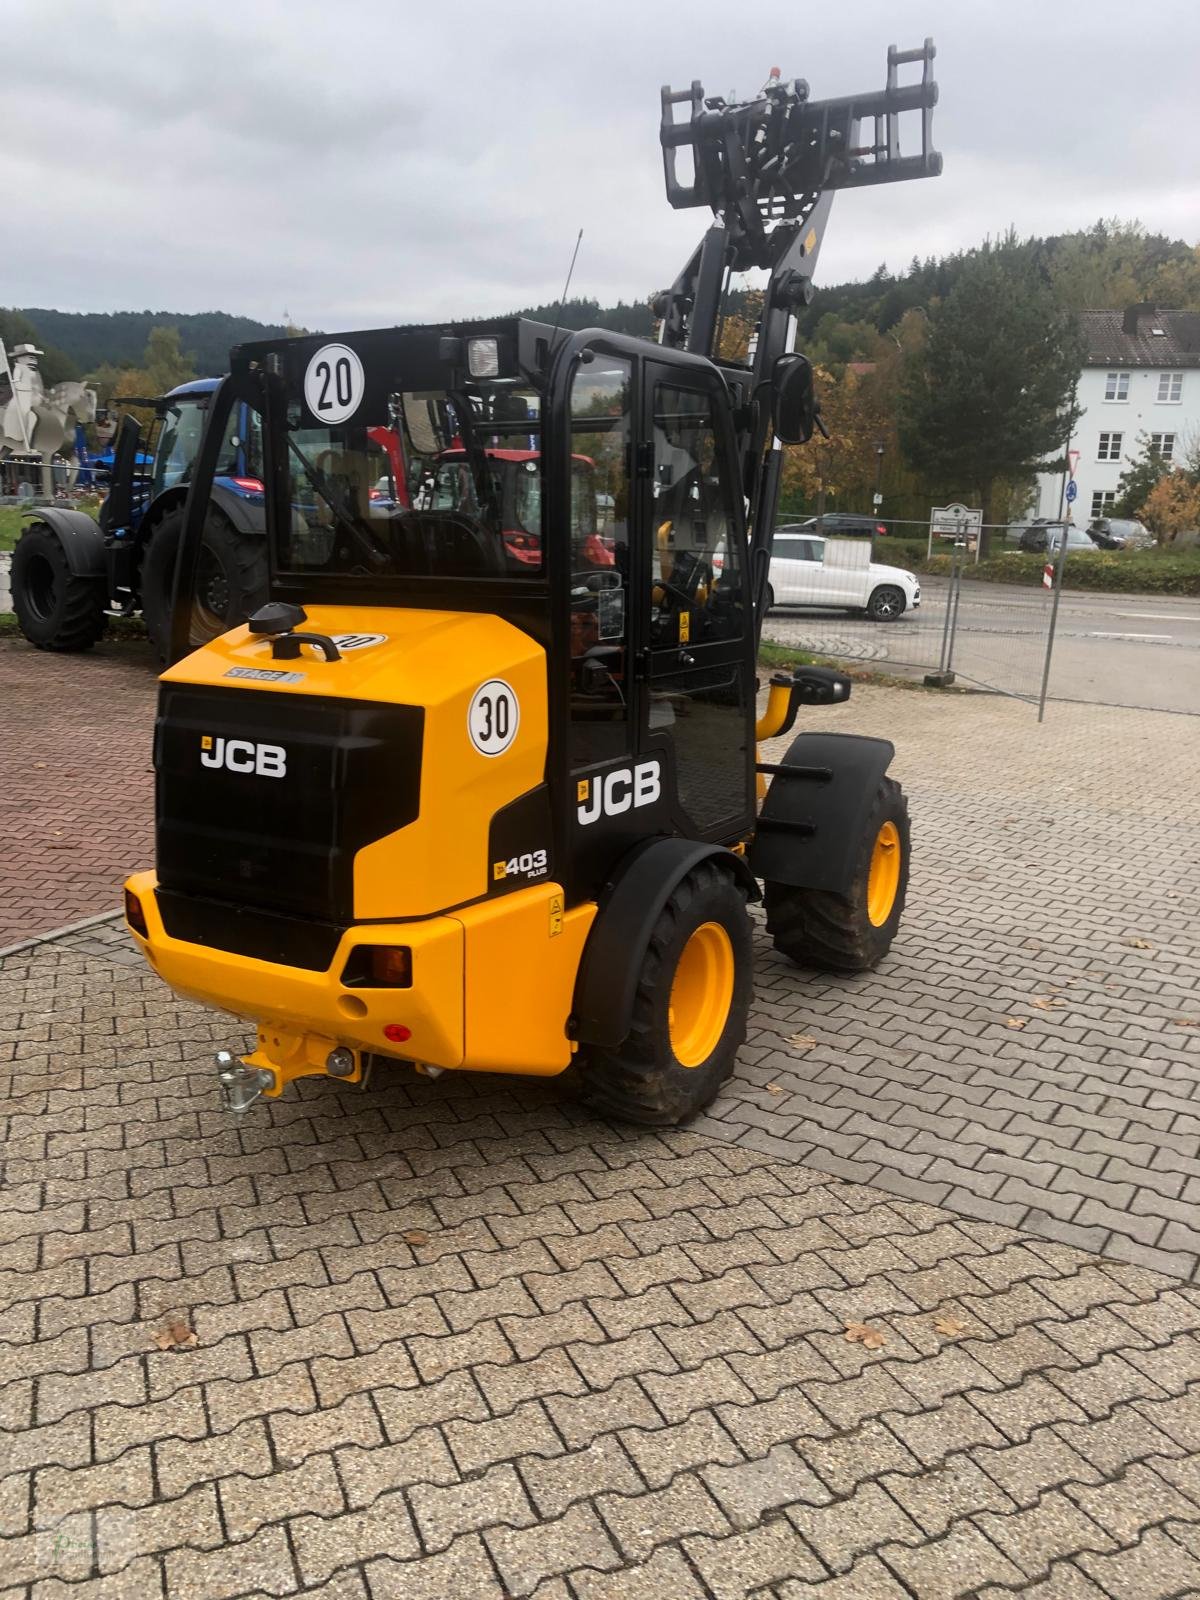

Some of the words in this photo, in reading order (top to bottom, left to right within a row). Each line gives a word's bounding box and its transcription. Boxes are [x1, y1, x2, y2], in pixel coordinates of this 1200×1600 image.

[316, 357, 352, 411] 20
[226, 668, 283, 681] STAGE
[479, 695, 509, 742] 30
[200, 737, 287, 778] JCB
[577, 760, 661, 826] JCB
[505, 849, 547, 875] 403
[527, 866, 548, 879] PLUS
